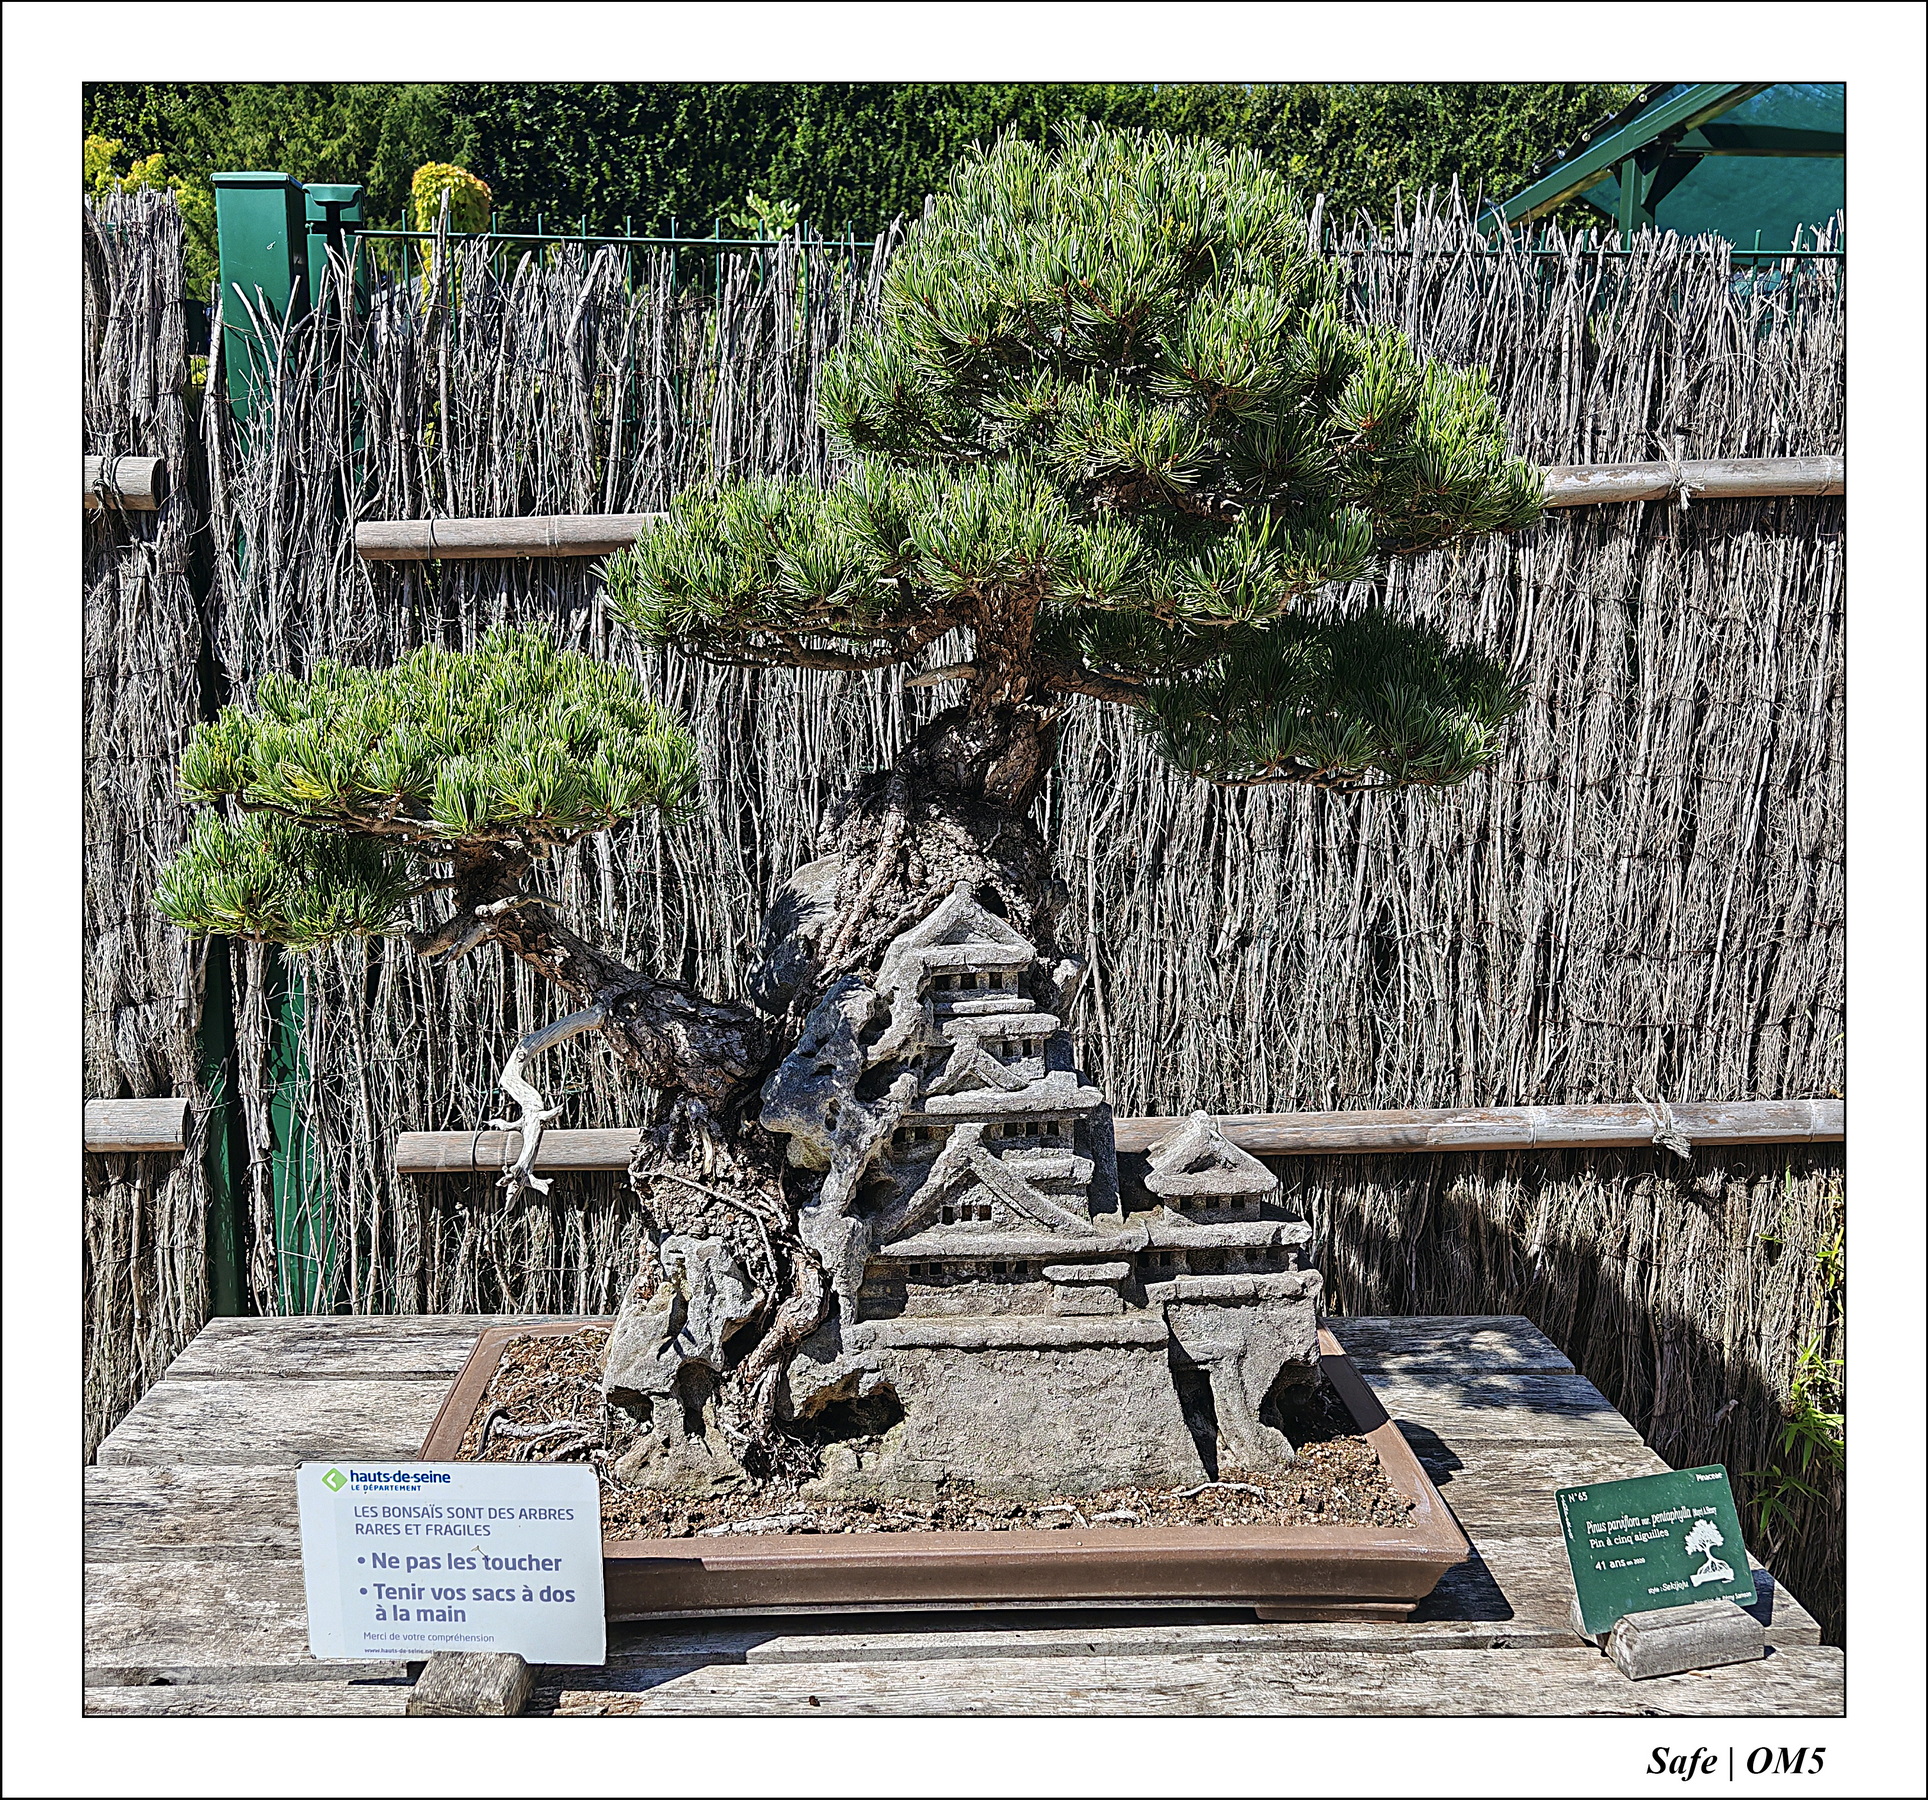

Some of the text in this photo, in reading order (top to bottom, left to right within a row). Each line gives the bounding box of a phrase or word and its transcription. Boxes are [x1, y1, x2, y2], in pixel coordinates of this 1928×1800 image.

[350, 1469, 451, 1484] hauts-de-seine
[363, 1483, 421, 1492] DÉPARTEMENT
[354, 1503, 575, 1521] LES BONSAÏS SONT DES ARBRES
[355, 1523, 491, 1537] RARES ET FRAGILES
[1586, 1519, 1607, 1535] Pinus
[1589, 1528, 1670, 1549] Pin à cinq aiguilles
[371, 1552, 562, 1573] Ne pas les toucher
[1595, 1560, 1606, 1571] 41
[1609, 1559, 1626, 1569] ans
[373, 1583, 576, 1603] Tenir vos sacs à dos
[375, 1604, 467, 1622] à la main
[363, 1631, 495, 1643] Merci de votre compréhension
